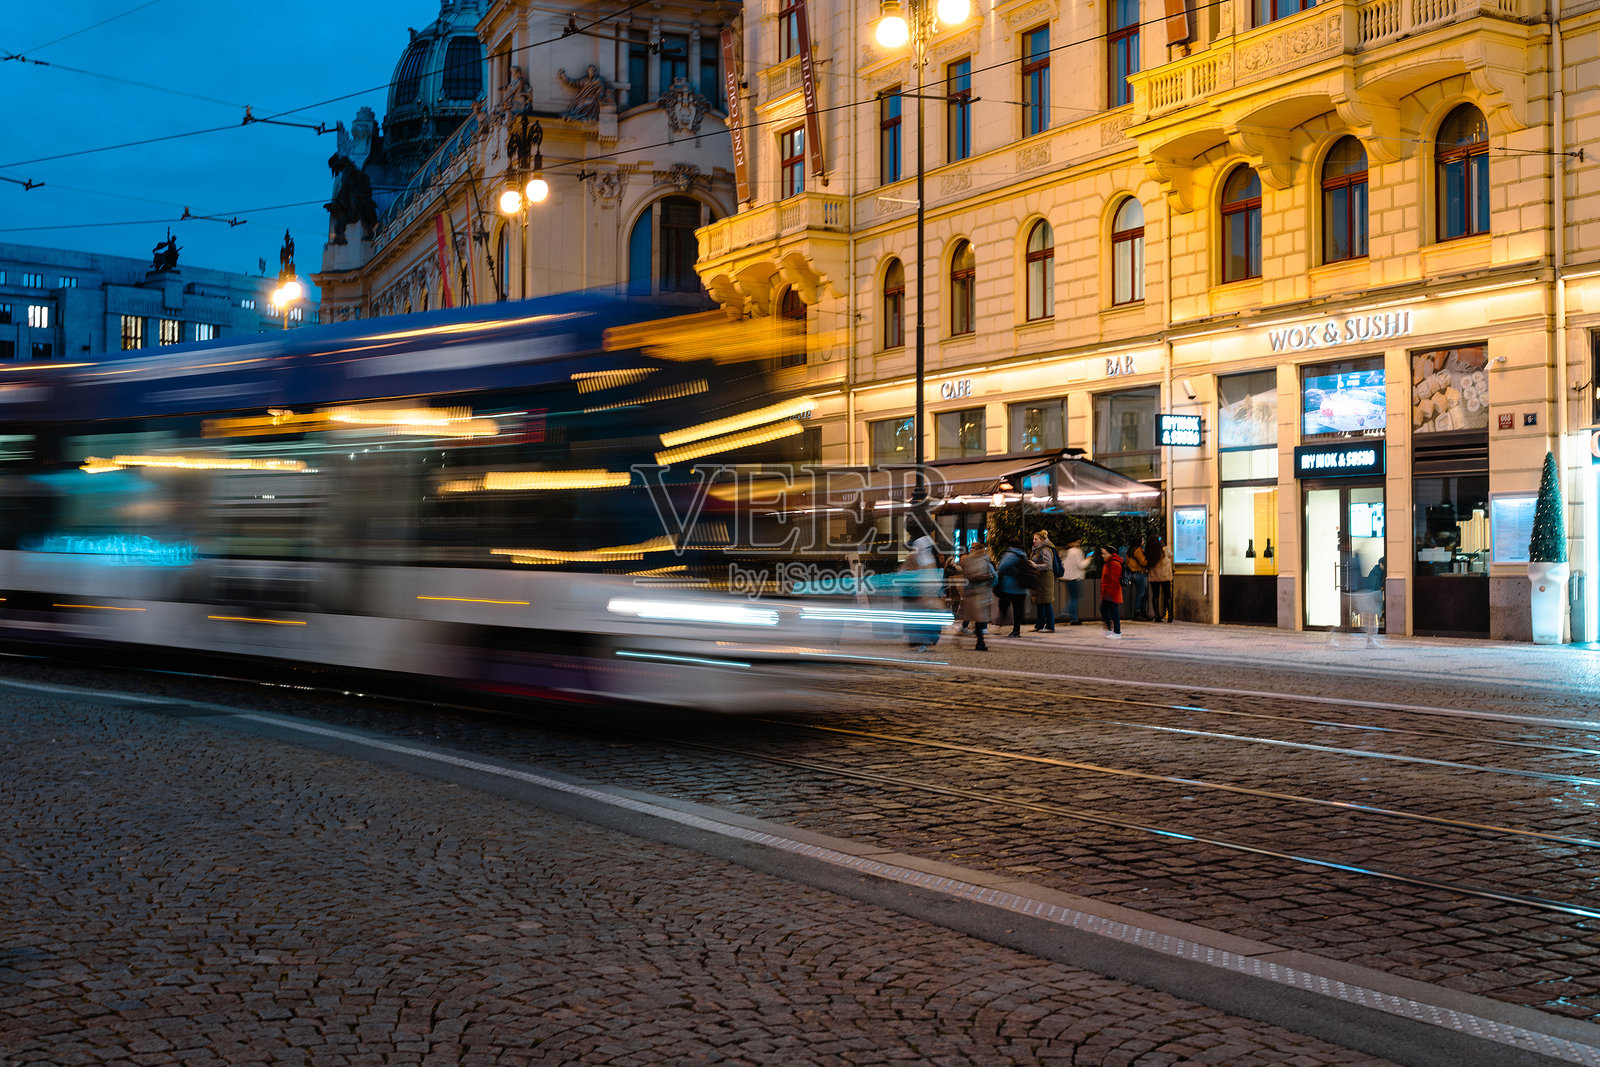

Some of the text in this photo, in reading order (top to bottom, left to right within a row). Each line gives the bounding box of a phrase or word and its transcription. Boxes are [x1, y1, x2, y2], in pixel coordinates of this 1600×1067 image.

[802, 51, 814, 109] HOTEL
[727, 71, 744, 167] KINGS COURT
[1268, 310, 1413, 352] WOK & SUSHI
[1105, 354, 1136, 377] BAR
[941, 377, 972, 400] CAFE
